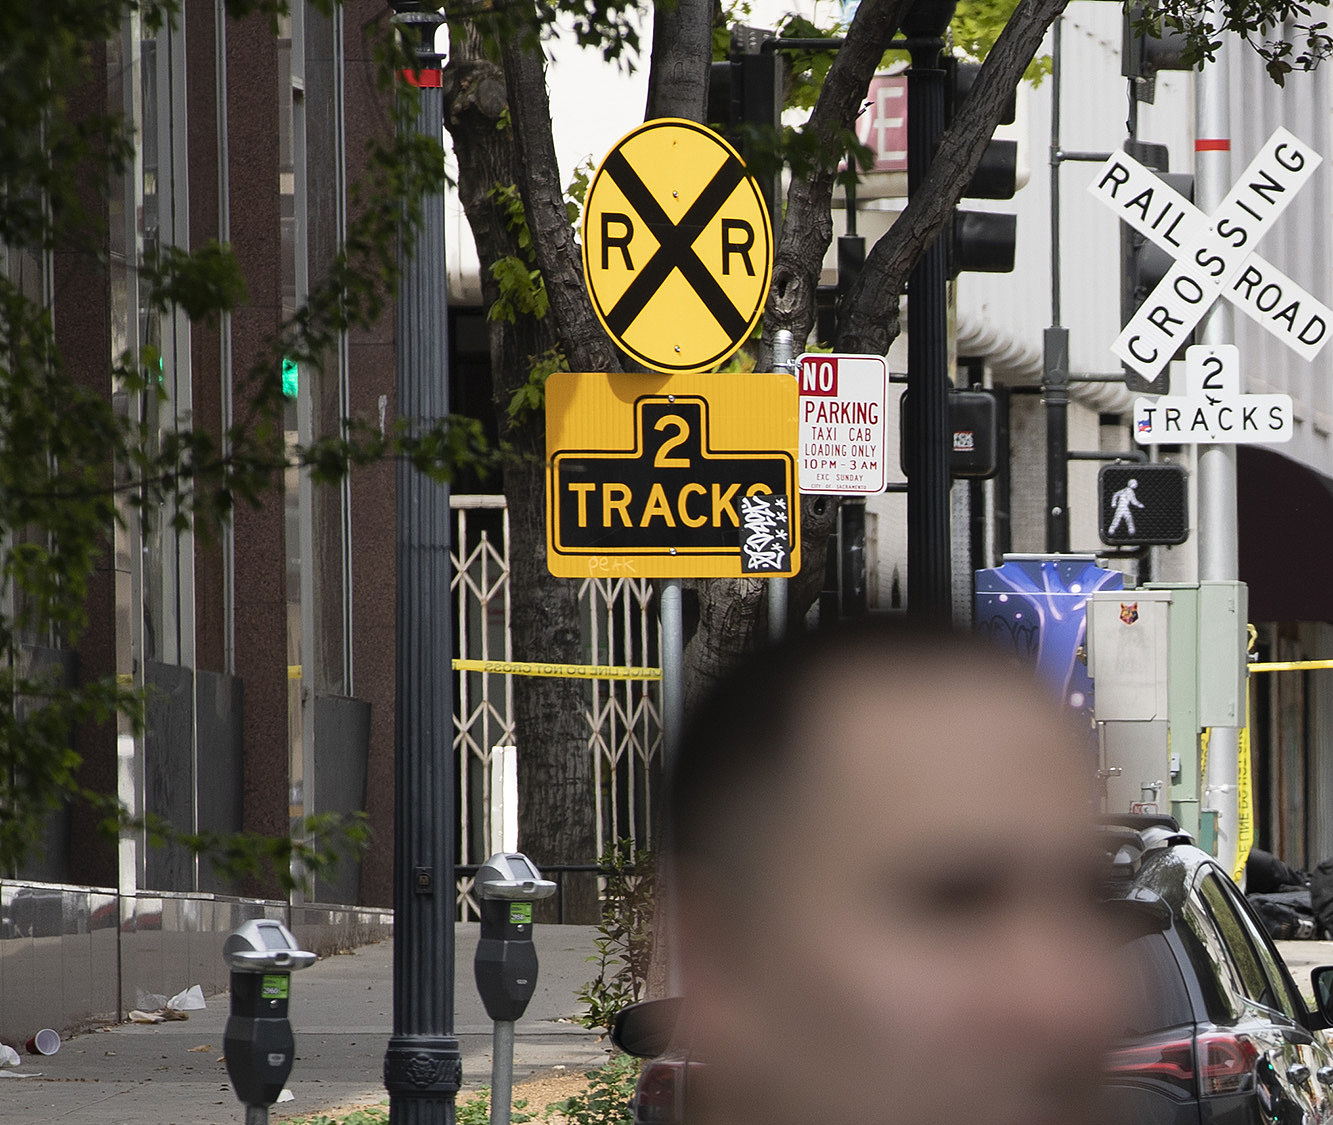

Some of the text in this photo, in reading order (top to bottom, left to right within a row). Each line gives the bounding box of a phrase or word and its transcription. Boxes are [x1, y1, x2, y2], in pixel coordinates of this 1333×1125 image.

[601, 212, 756, 277] R R
[1098, 162, 1326, 346] RAIL ROAD
[1128, 143, 1305, 364] CROSSING
[803, 362, 834, 392] NO
[1202, 357, 1224, 390] 2
[805, 401, 878, 425] PARKING
[1143, 406, 1284, 431] TRACKS
[653, 414, 691, 468] 2
[812, 427, 871, 442] TAXI CAB
[805, 443, 877, 458] LOADING ONLY
[816, 473, 863, 482] EXC SUNDAY
[568, 483, 773, 528] TRACK
